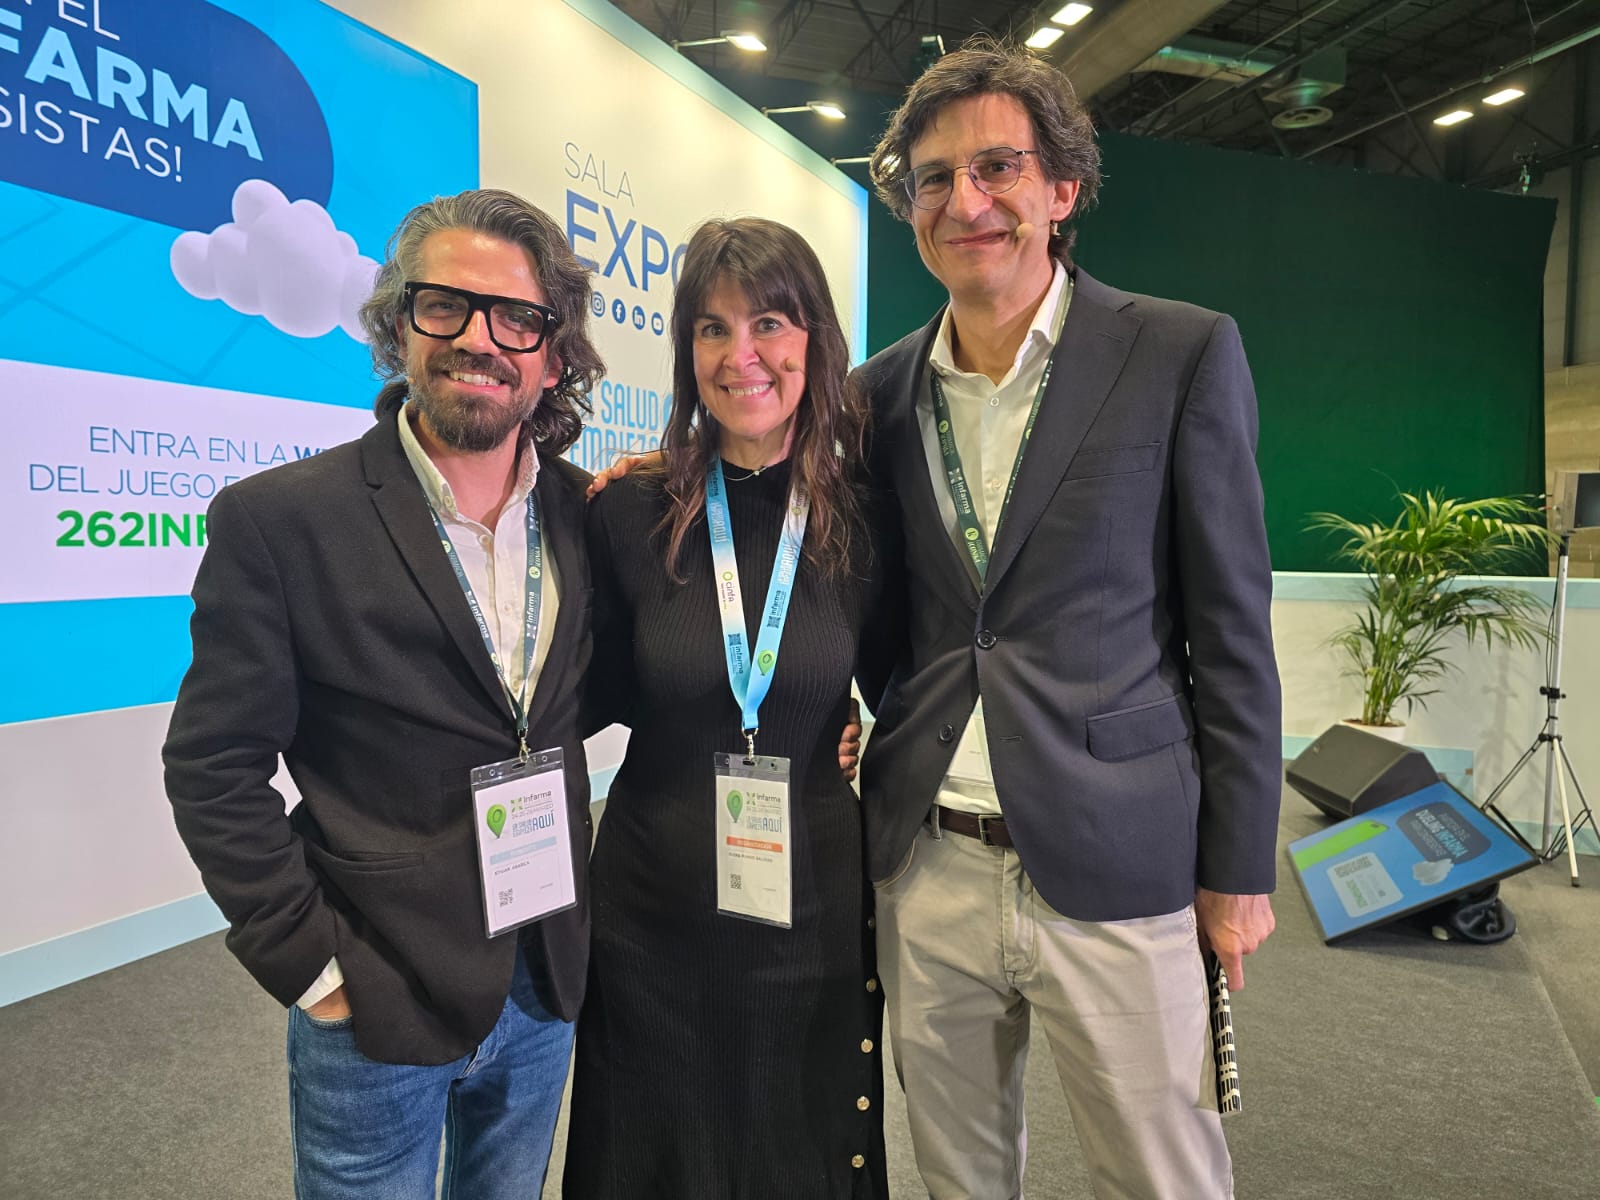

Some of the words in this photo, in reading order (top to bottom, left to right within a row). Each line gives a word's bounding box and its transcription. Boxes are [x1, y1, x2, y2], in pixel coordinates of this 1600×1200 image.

[58, 0, 120, 41] EL
[564, 142, 635, 208] SALA
[601, 380, 659, 431] SALUD
[89, 426, 200, 460] ENTRA
[208, 437, 246, 463] EN
[255, 441, 288, 465] LA
[29, 463, 99, 494] DEL
[107, 469, 216, 499] JUEGO
[957, 480, 971, 514] infarma
[470, 604, 490, 639] infarma
[526, 591, 535, 624] infarma
[523, 790, 552, 804] infarma
[532, 809, 555, 832] AQUÍ
